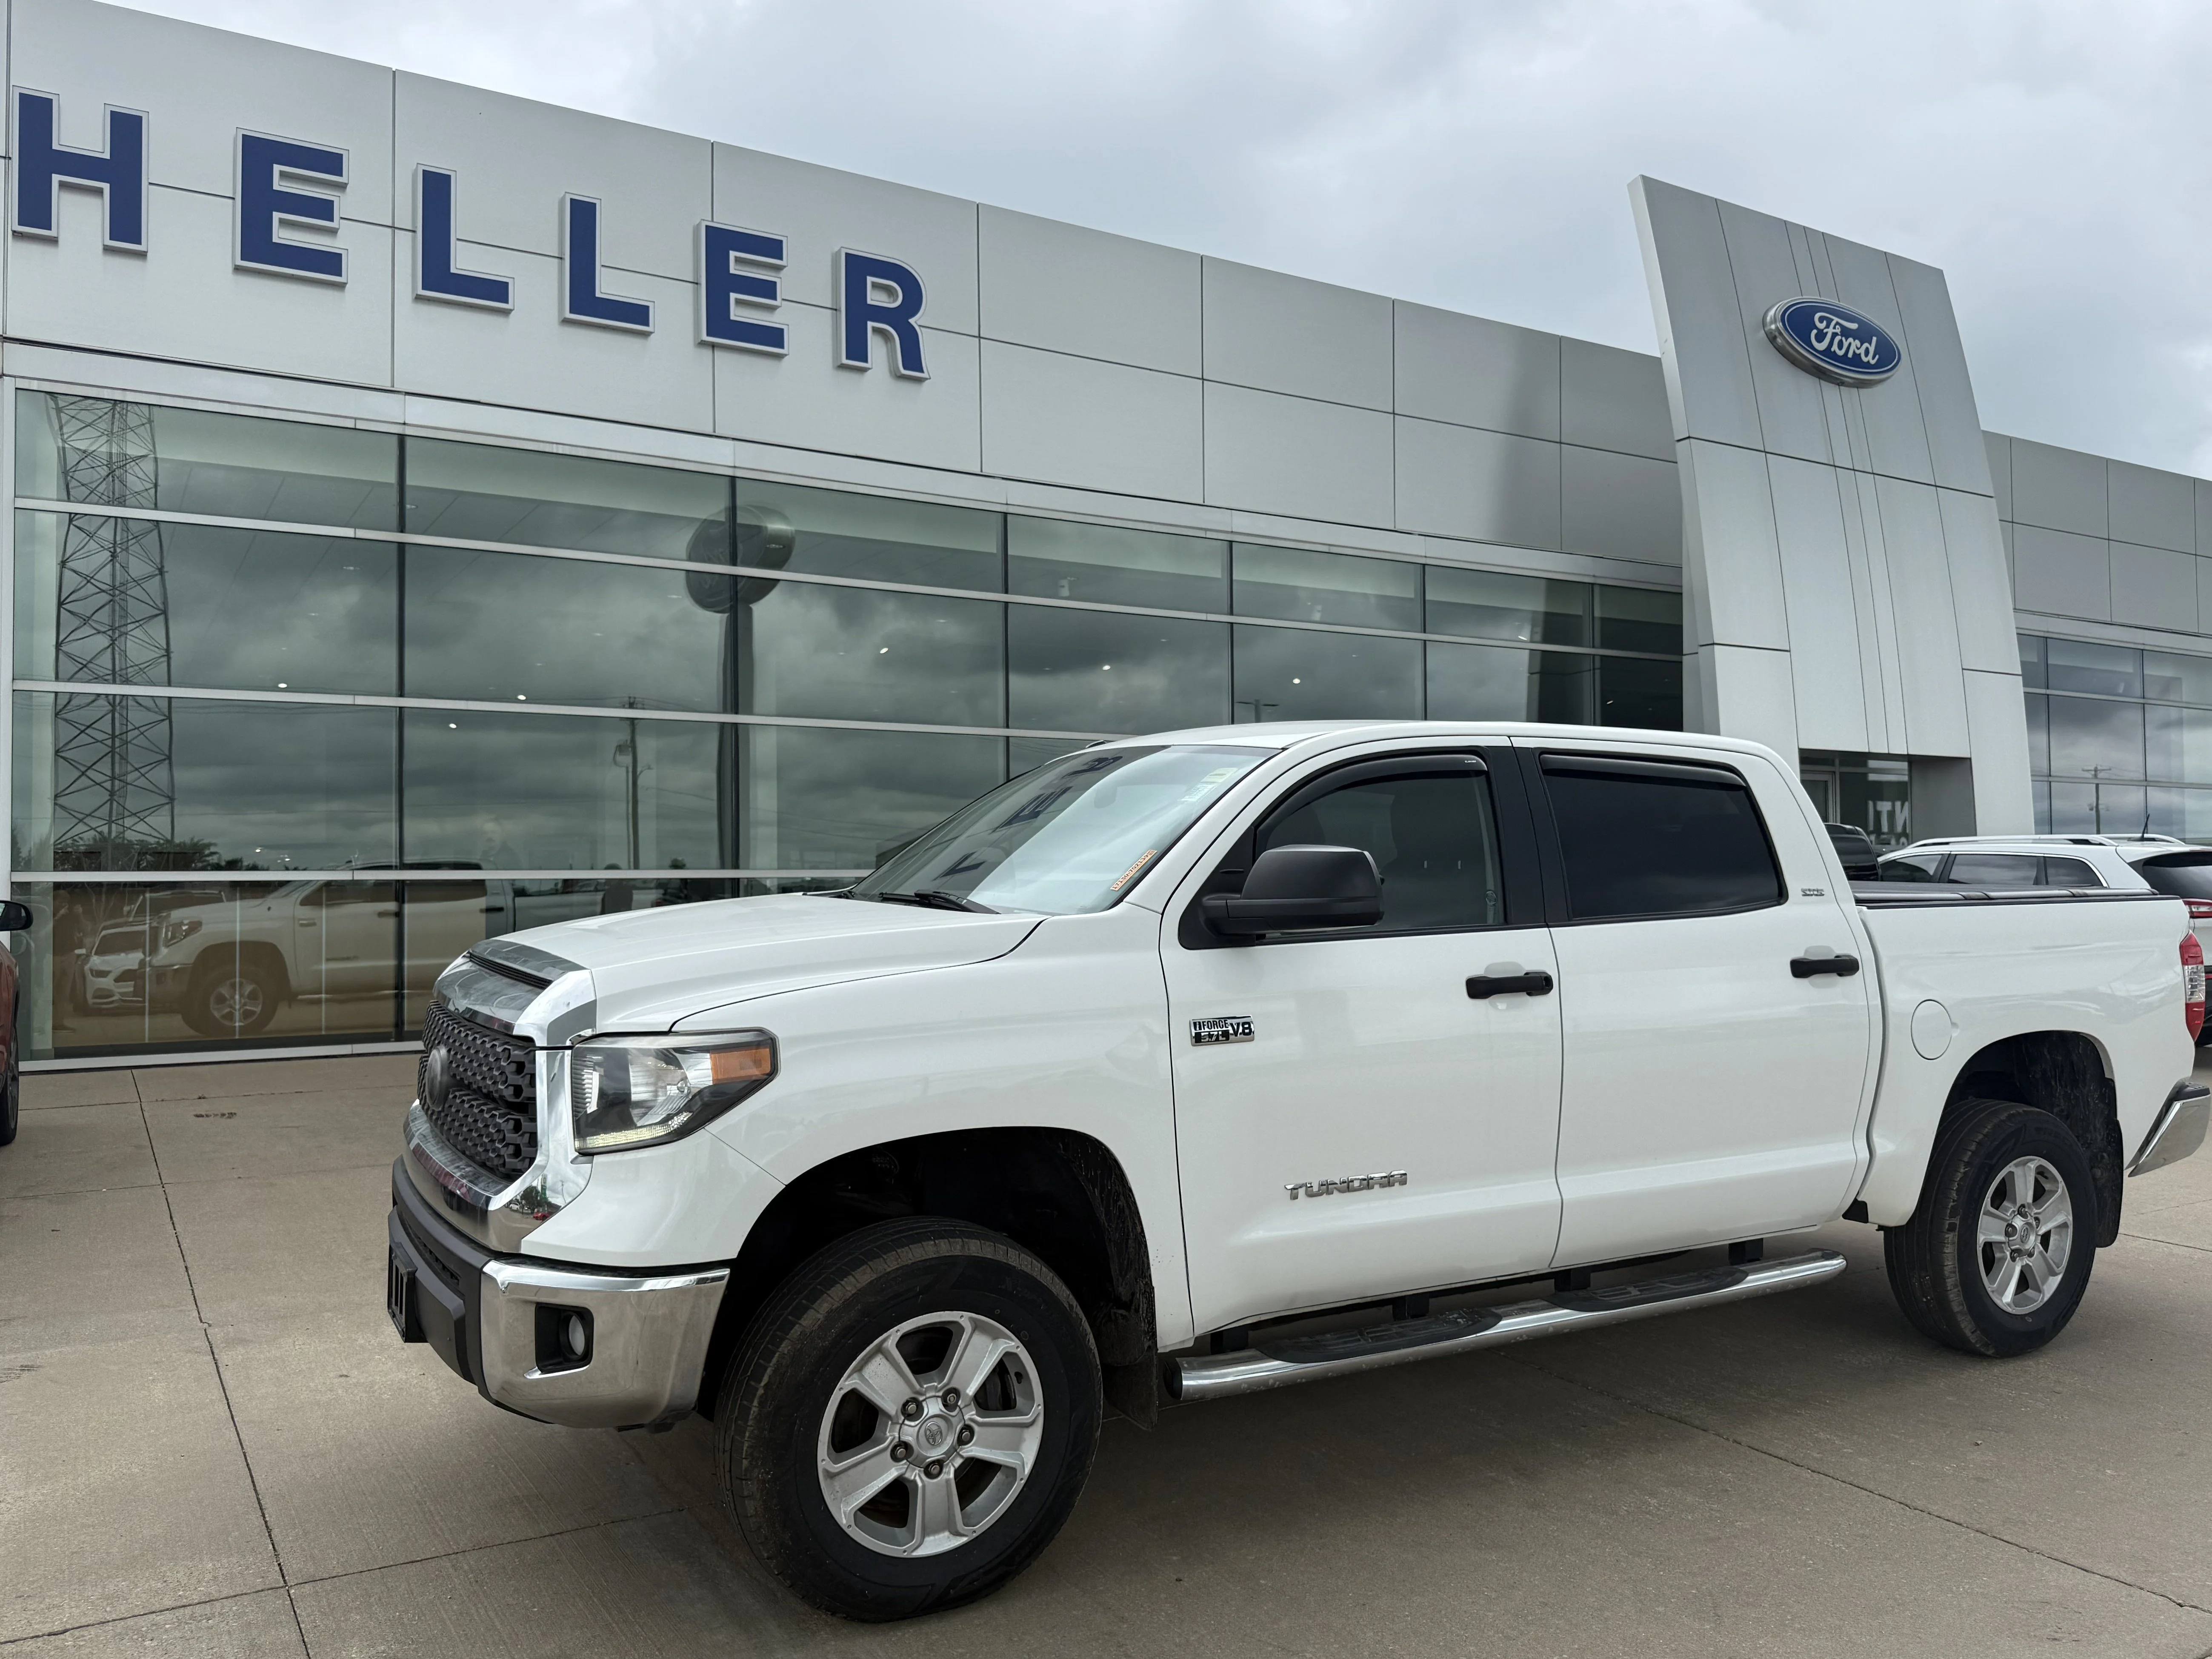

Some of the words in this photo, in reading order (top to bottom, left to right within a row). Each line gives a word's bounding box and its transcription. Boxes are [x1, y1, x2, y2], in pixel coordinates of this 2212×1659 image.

[13, 85, 930, 380] HELLER
[1810, 312, 1879, 365] Ford
[1229, 1021, 1252, 1037] V8
[1284, 1170, 1408, 1200] TUNDRA
